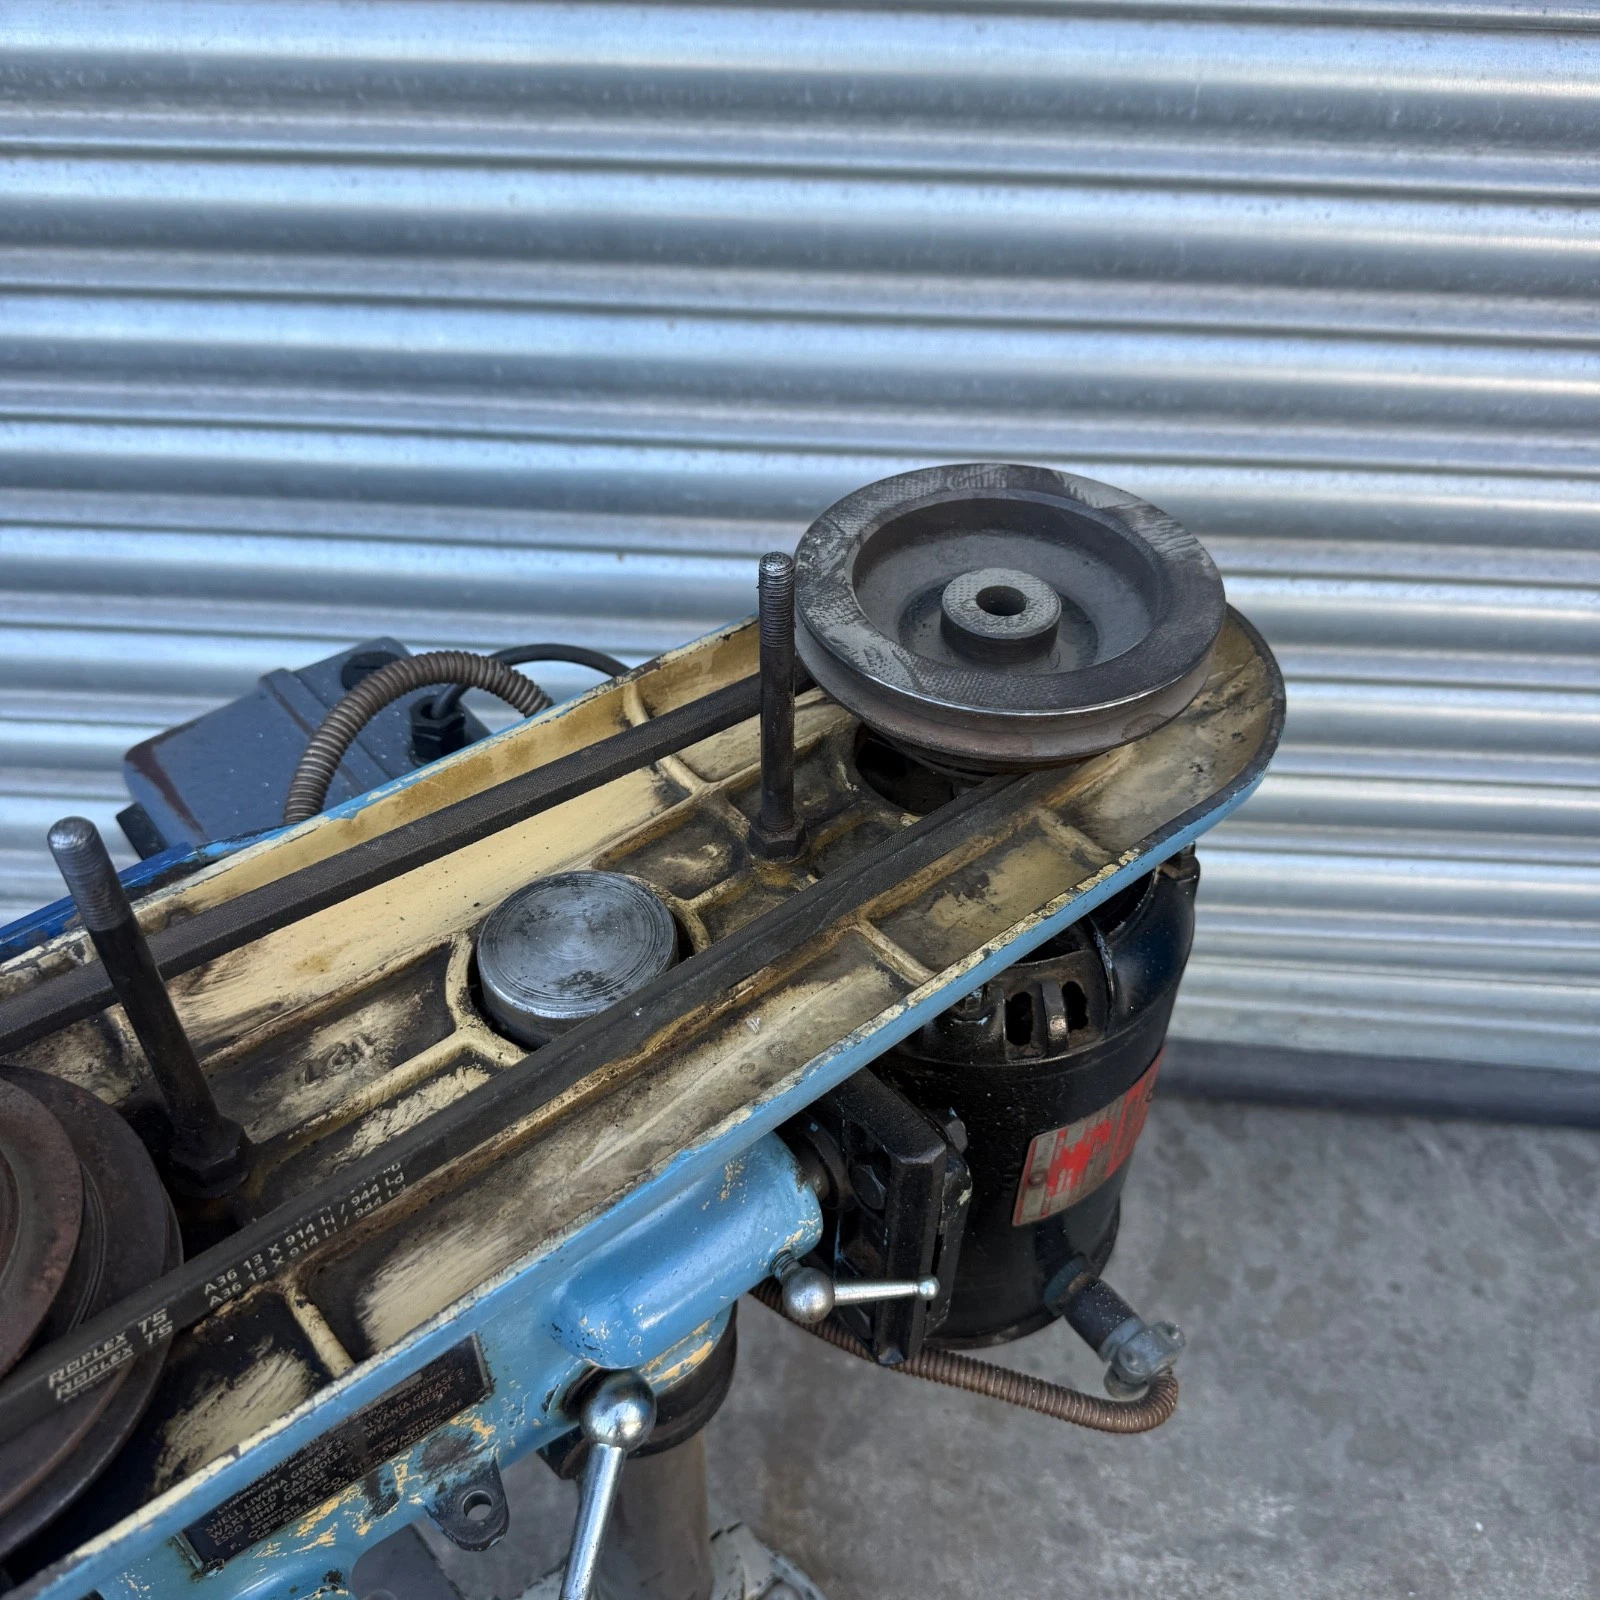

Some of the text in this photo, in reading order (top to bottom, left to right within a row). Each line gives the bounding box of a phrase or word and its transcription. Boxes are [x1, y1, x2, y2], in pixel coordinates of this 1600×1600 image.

[204, 1269, 238, 1296] A36
[243, 1254, 263, 1271] 13
[285, 1223, 316, 1246] 914
[351, 1183, 380, 1206] 944
[384, 1172, 405, 1186] Ld
[209, 1281, 242, 1308] A36
[248, 1266, 268, 1281] 13
[289, 1235, 320, 1257] 914
[354, 1196, 382, 1218] 944
[49, 1331, 127, 1389] ROFLEX
[57, 1344, 134, 1400] ROFLEX
[204, 1506, 241, 1534] SHELL
[243, 1476, 288, 1510] LIVONA
[289, 1444, 335, 1480] GREASE
[209, 1492, 277, 1540] WAKEFIELD
[213, 1468, 327, 1546] ESSO HMP GREASE
[320, 1472, 345, 1492] CO.
